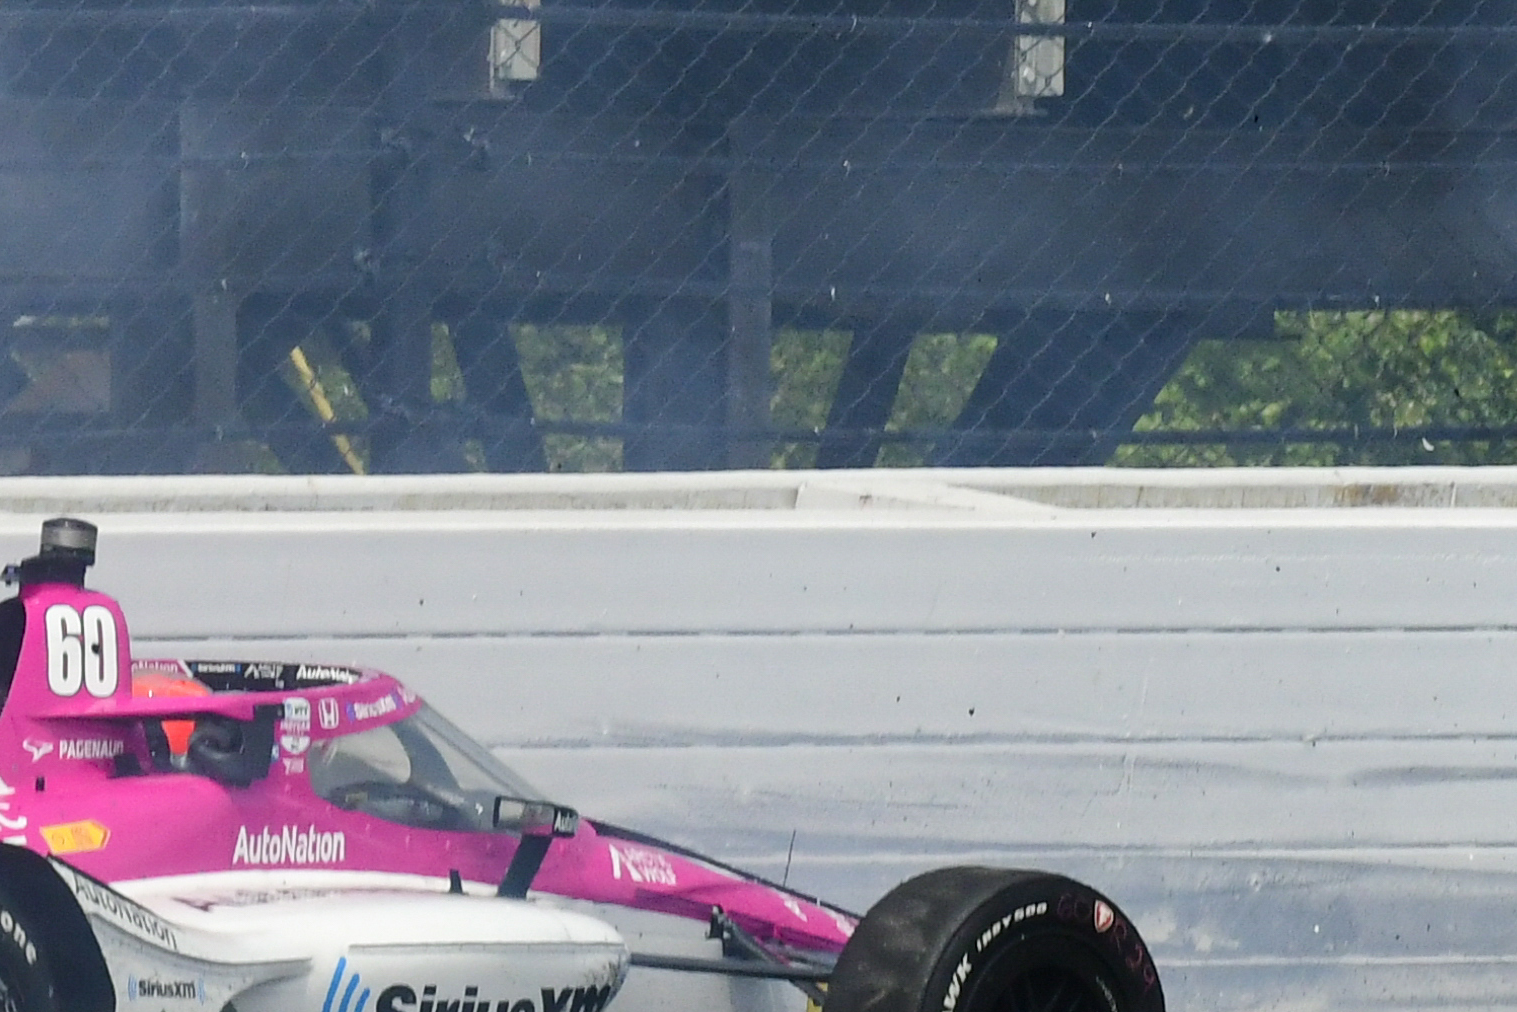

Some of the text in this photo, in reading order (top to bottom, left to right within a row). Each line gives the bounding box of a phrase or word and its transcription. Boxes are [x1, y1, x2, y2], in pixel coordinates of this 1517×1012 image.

[46, 604, 118, 698] 60
[232, 815, 346, 864] AutoNation
[74, 873, 178, 950] AutoNation
[138, 979, 196, 999] SiriusXM
